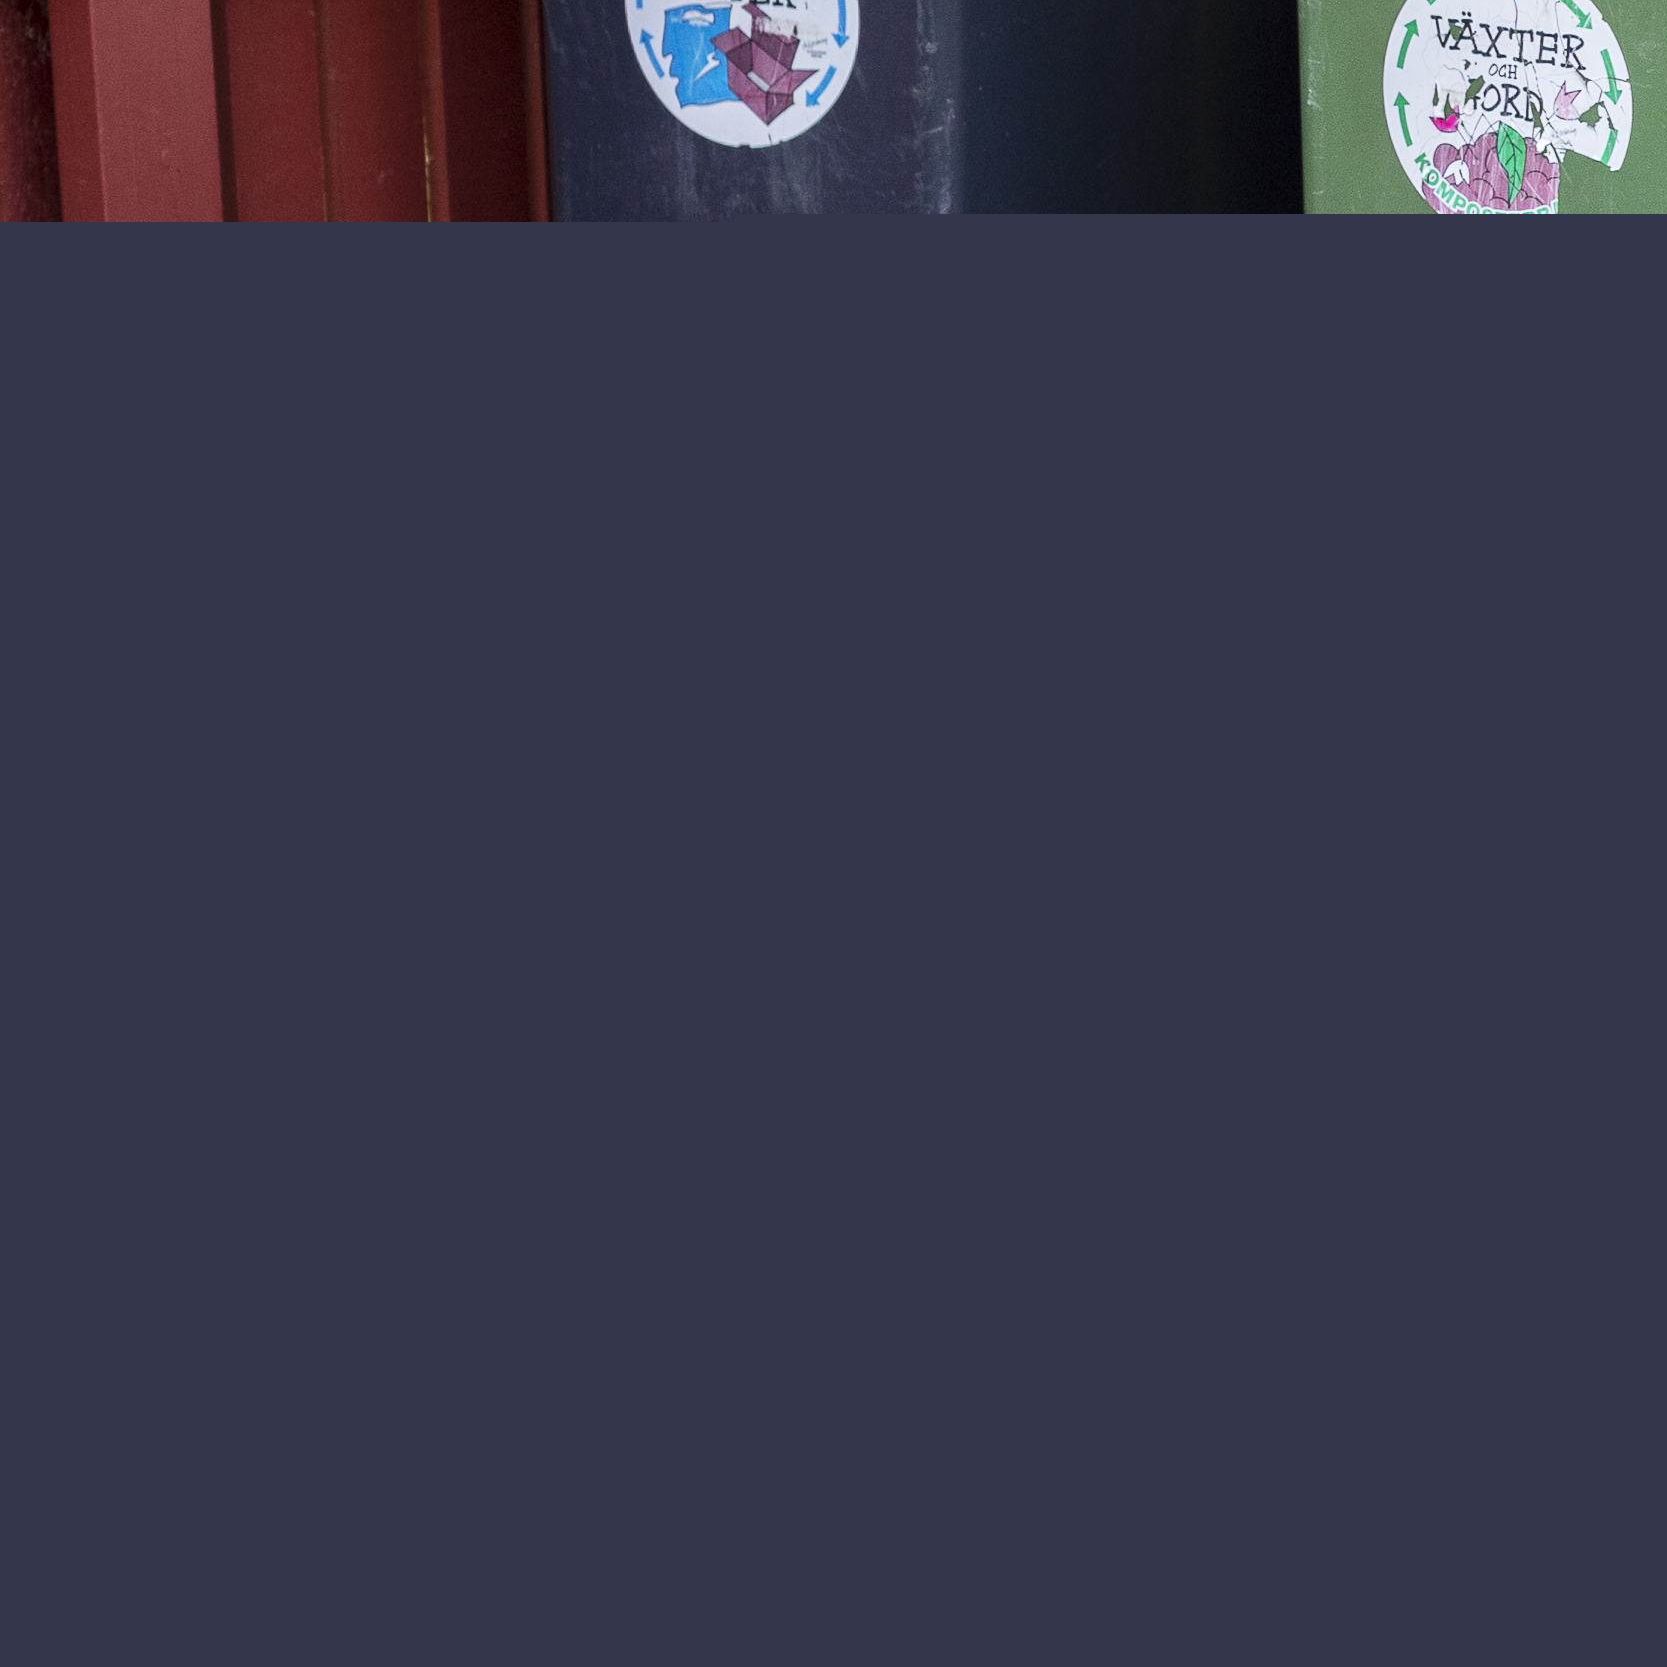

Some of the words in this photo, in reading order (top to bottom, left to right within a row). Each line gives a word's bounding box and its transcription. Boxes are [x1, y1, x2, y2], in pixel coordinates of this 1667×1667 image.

[1430, 10, 1586, 71] VÄXTER
[1488, 62, 1518, 80] OCH
[1471, 83, 1544, 123] ORD
